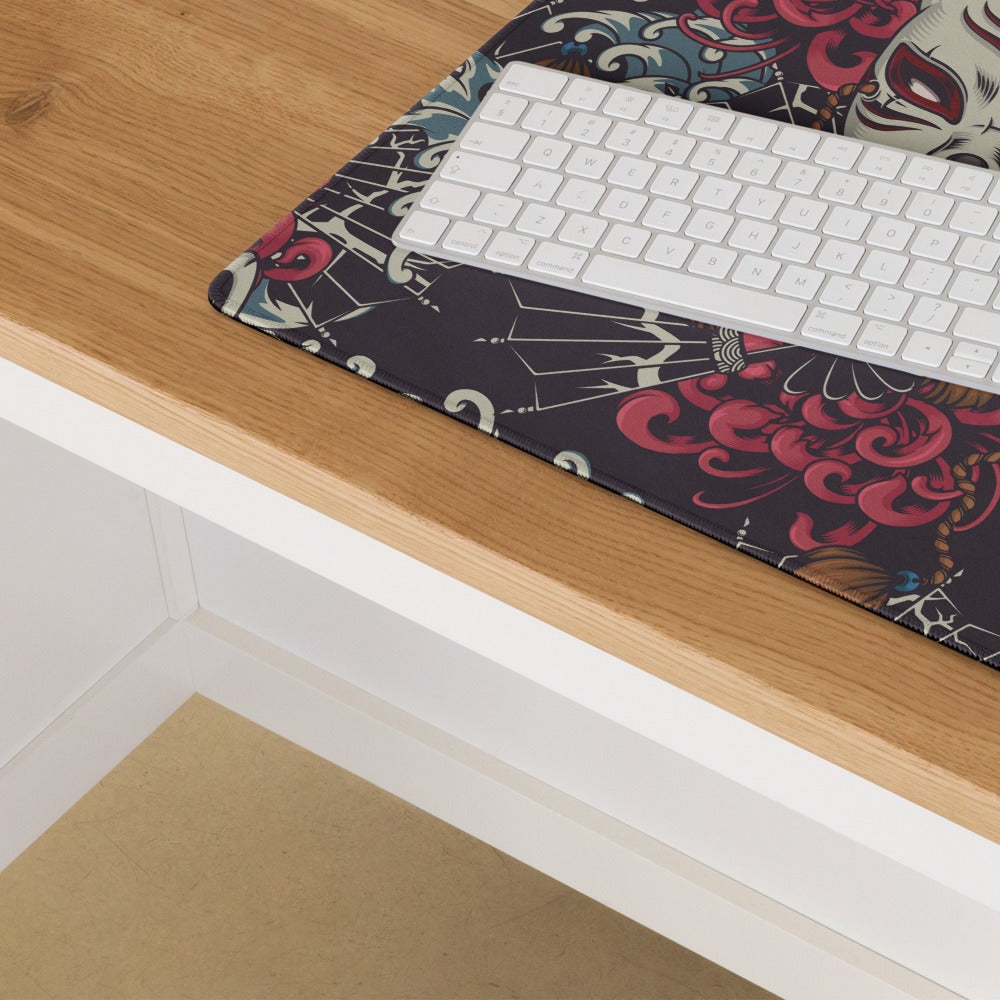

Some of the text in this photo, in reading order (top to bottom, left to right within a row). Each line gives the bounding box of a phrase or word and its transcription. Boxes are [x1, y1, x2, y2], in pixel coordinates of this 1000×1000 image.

[543, 148, 553, 157] Q
[585, 158, 597, 166] W
[627, 168, 637, 177] E
[670, 178, 679, 186] R
[715, 188, 723, 196] T
[758, 198, 766, 206] Y
[799, 208, 809, 217] U
[886, 229, 896, 238] O
[580, 128, 590, 137] 2
[621, 138, 631, 147] 3
[707, 158, 716, 166] 5
[750, 168, 759, 176] 6
[793, 178, 802, 186] 7
[836, 188, 845, 196] 8
[879, 198, 888, 206] 9
[923, 208, 932, 217] 0
[533, 180, 542, 189] A
[618, 200, 629, 209] D
[662, 210, 671, 218] F
[705, 221, 715, 230] G
[748, 231, 759, 240] H
[792, 242, 801, 250] J
[836, 252, 845, 260] K
[880, 262, 886, 271] L
[535, 216, 807, 286] Z X C V B N M
[450, 239, 479, 249] control
[495, 249, 520, 260] option
[536, 260, 575, 274] command
[807, 326, 847, 340] command
[863, 338, 889, 350] option
